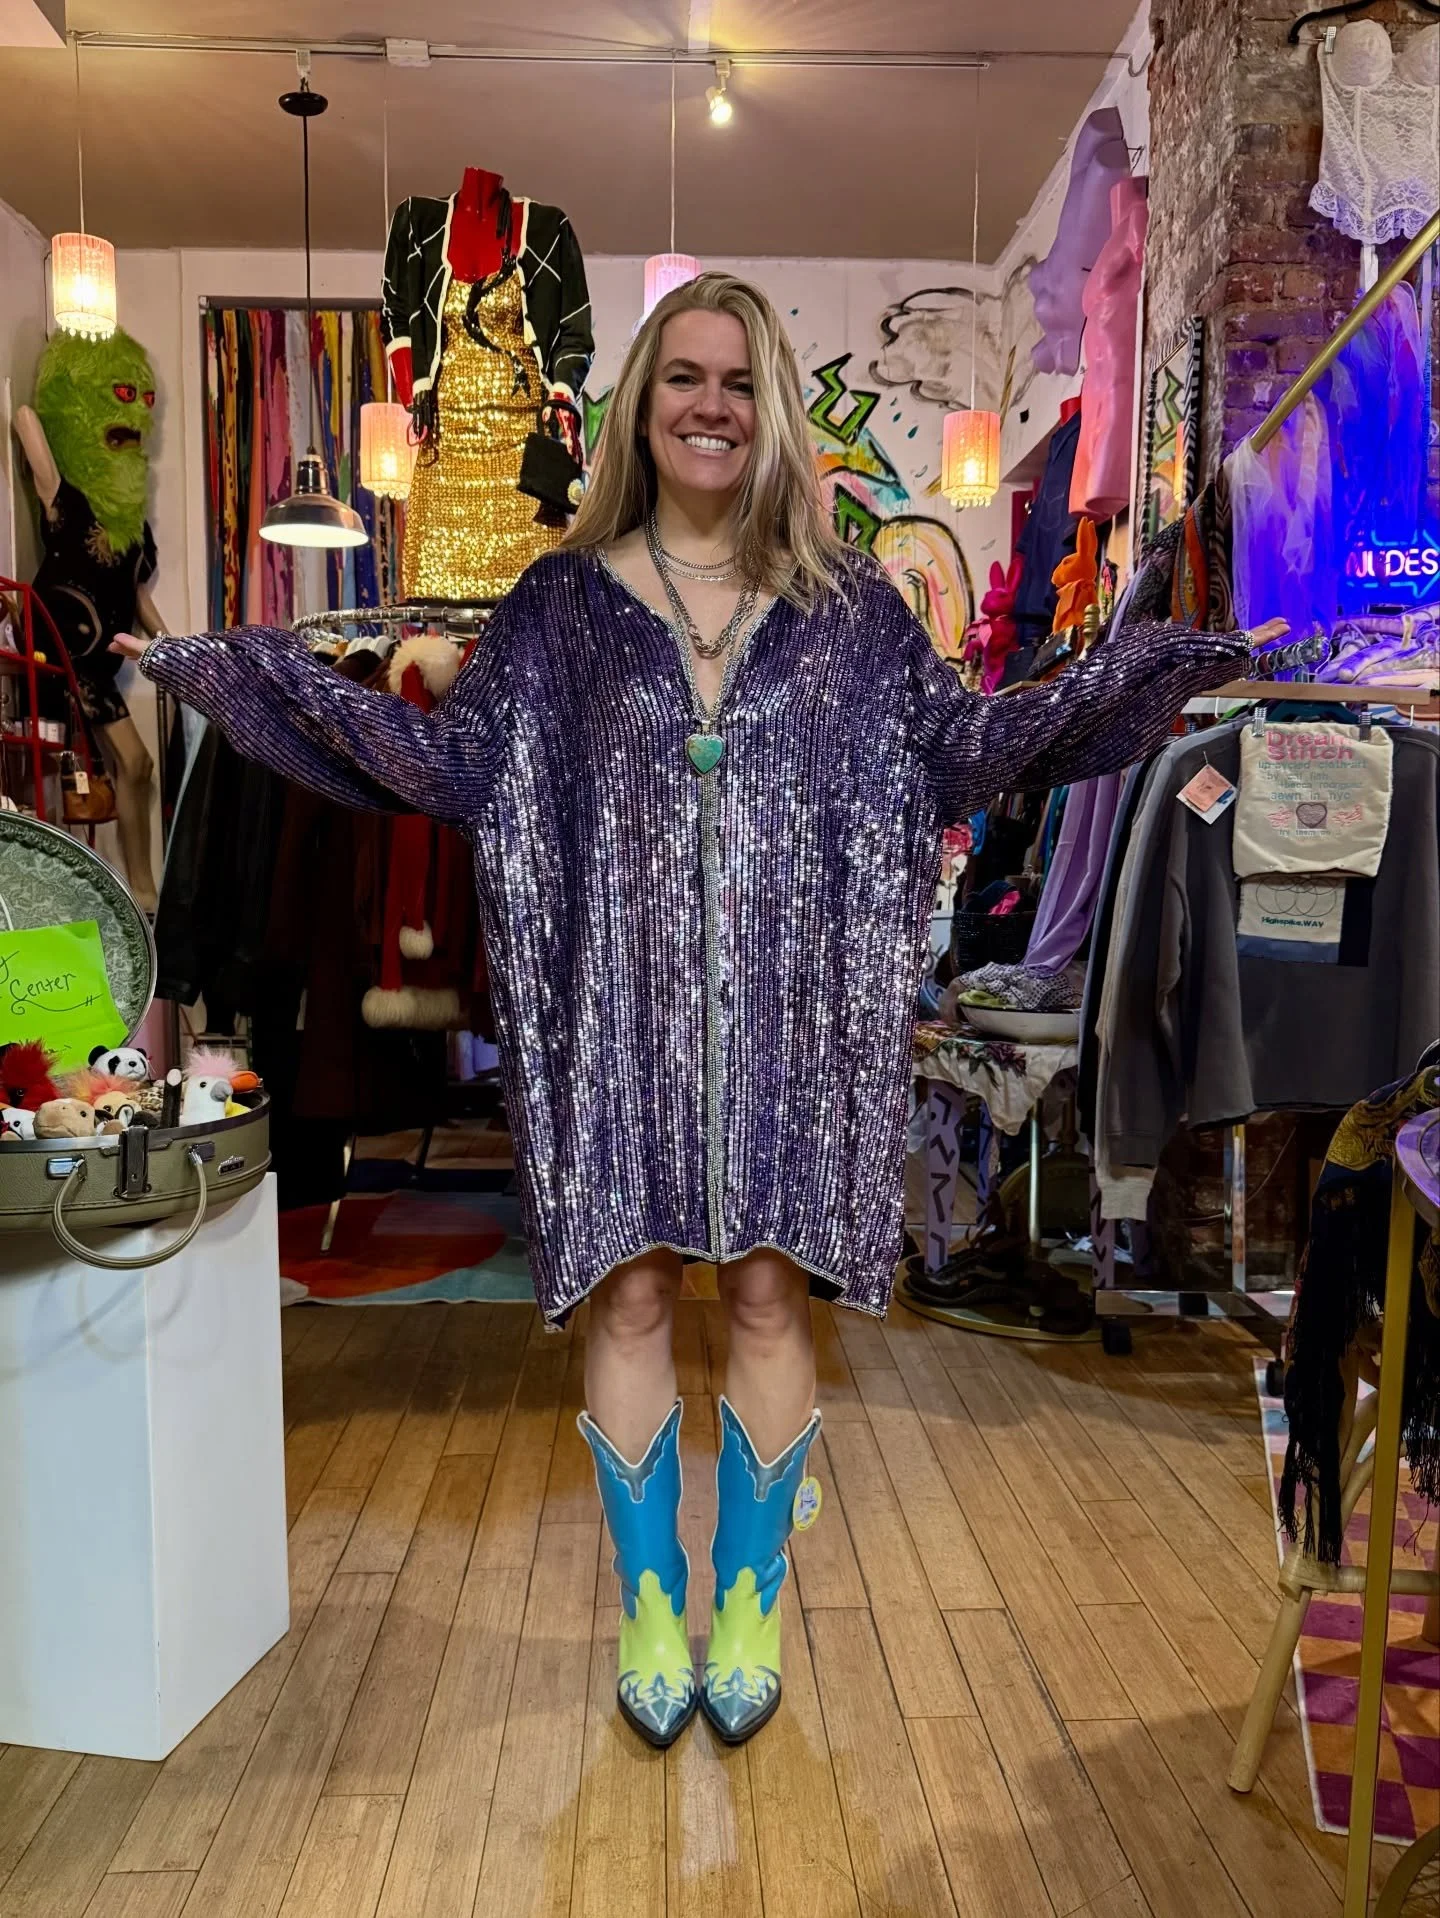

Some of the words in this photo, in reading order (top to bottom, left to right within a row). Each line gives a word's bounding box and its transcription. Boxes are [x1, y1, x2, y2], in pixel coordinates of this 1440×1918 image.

[1267, 744, 1353, 761] Stitch
[1310, 790, 1320, 801] in
[1328, 790, 1352, 803] nyc
[9, 973, 77, 1002] Center
